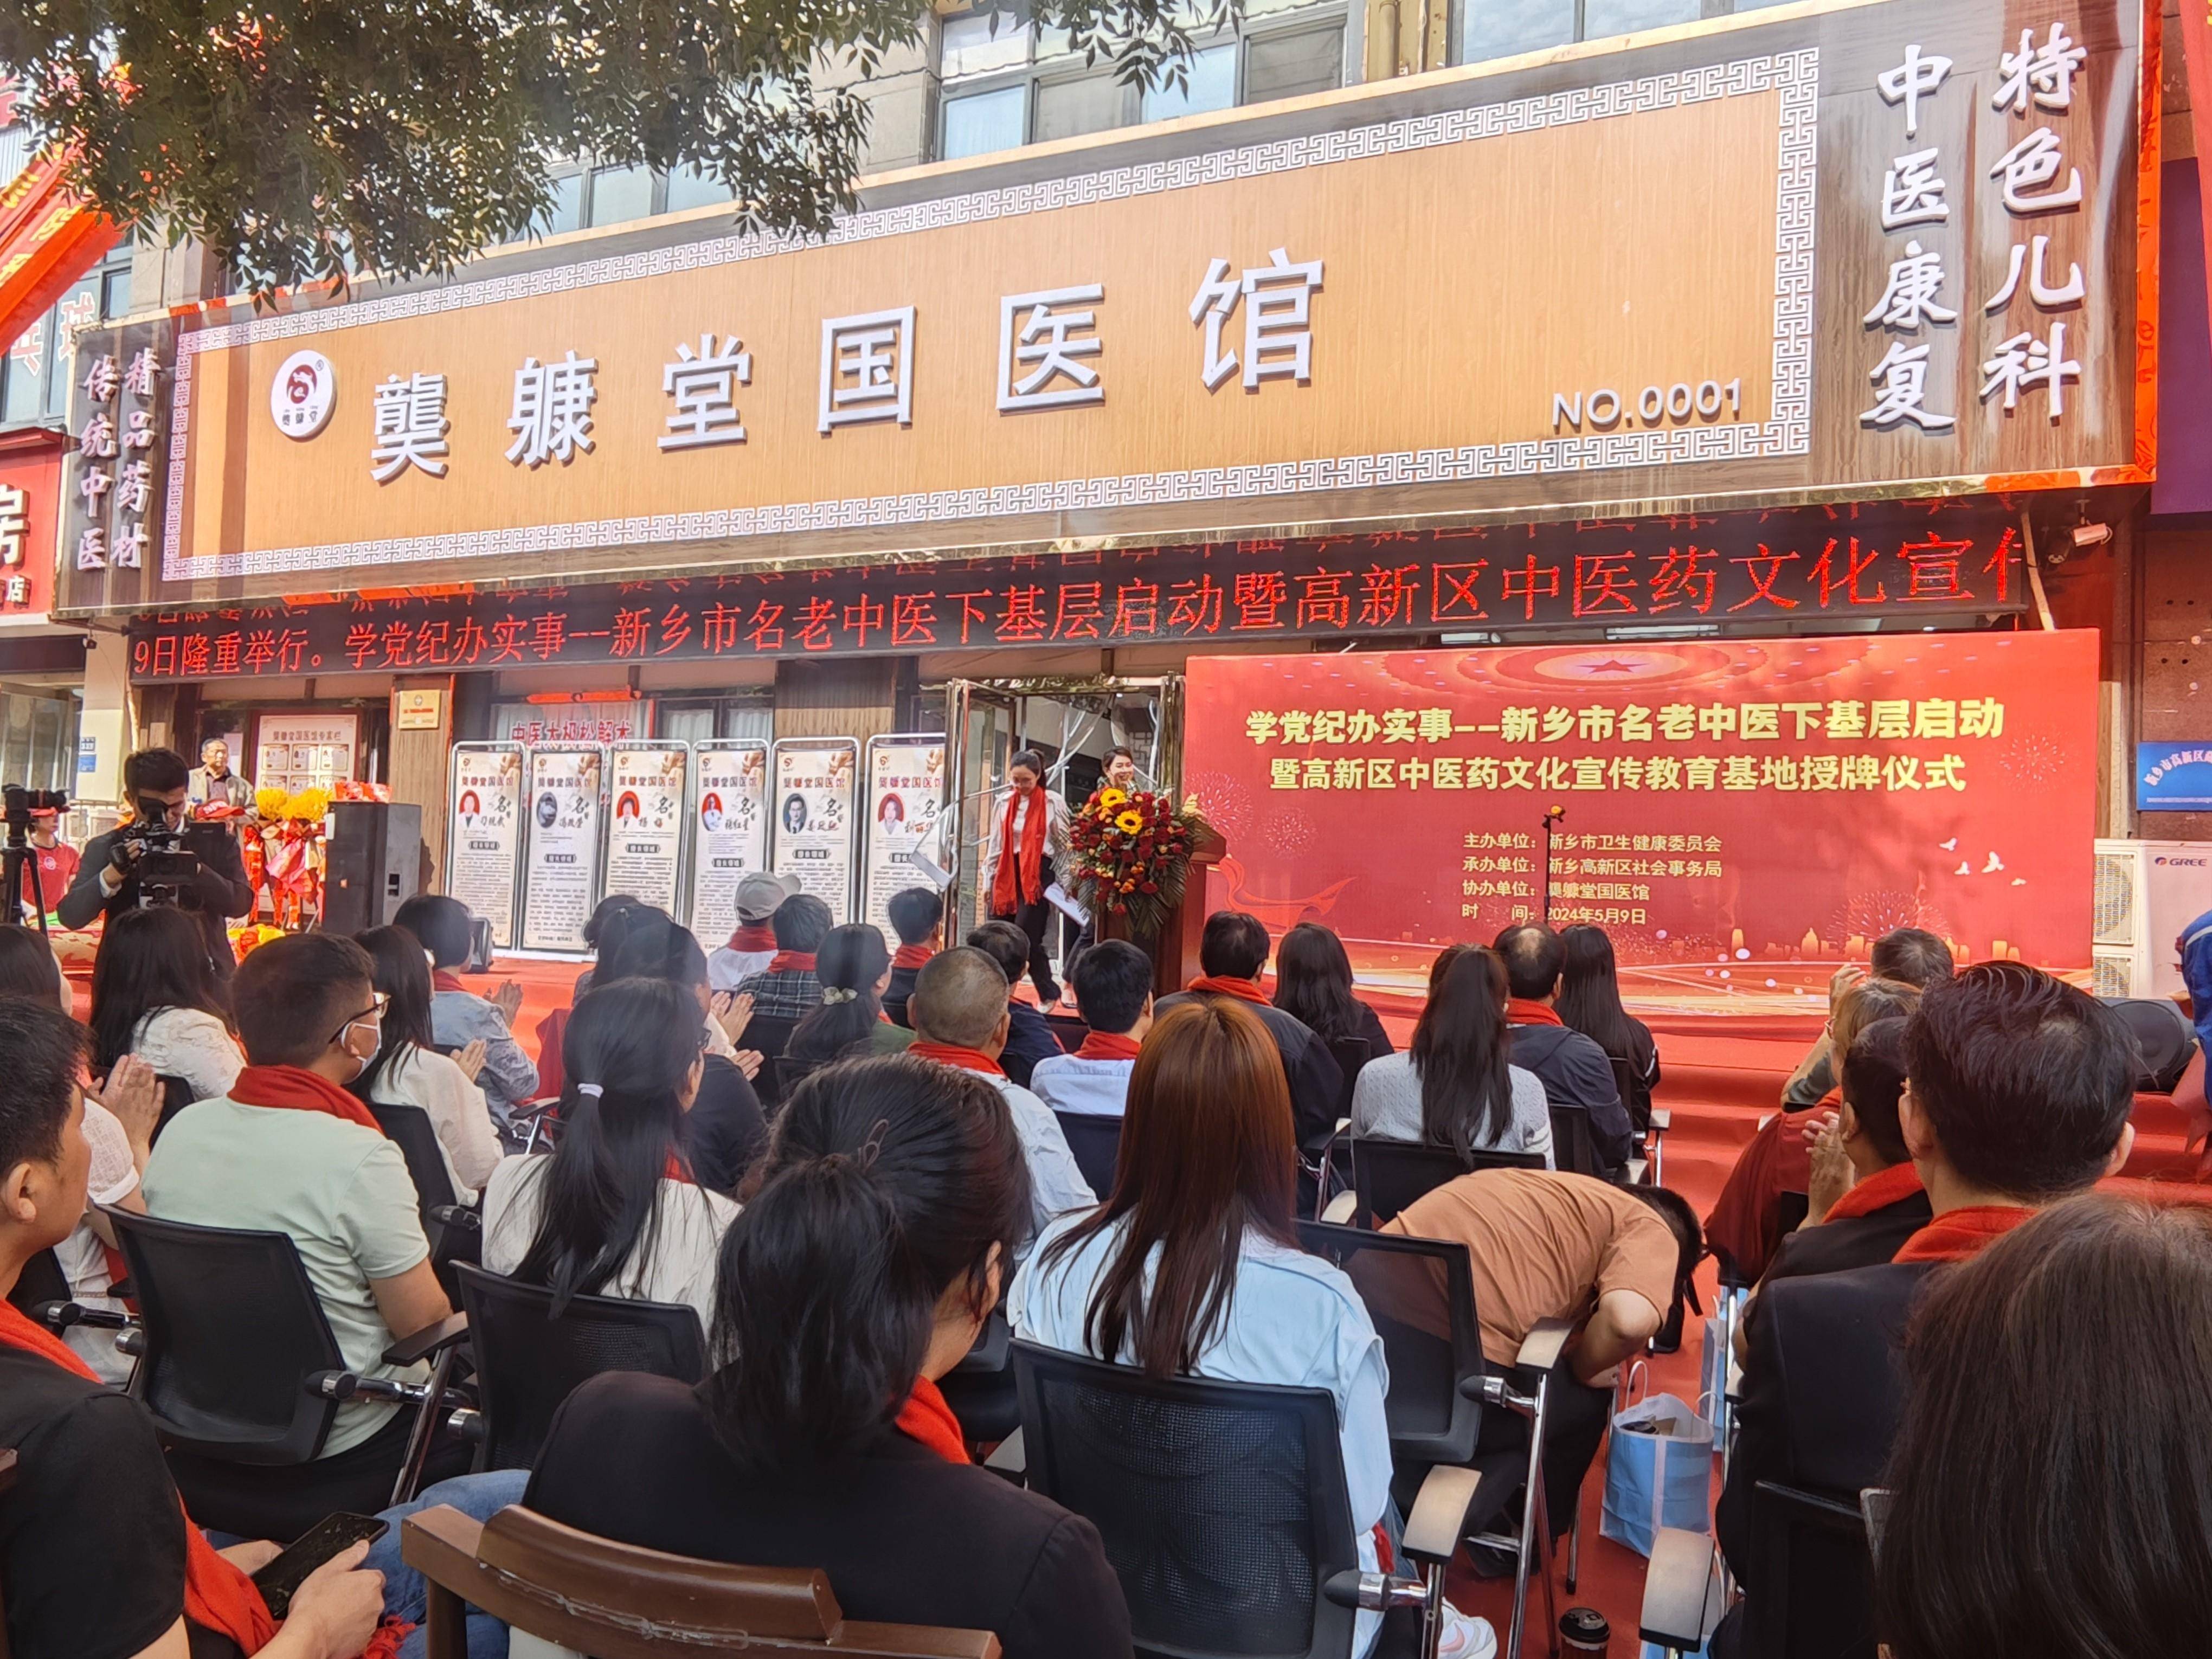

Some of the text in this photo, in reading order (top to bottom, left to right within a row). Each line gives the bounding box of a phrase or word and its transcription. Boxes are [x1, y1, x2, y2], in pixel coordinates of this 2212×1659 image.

[1860, 44, 1957, 428] 中医康复
[1979, 22, 2086, 417] 特色儿科
[78, 355, 118, 570] 传统中医
[112, 348, 160, 568] 精品药材
[1552, 378, 1740, 426] NO.0001
[1270, 755, 1966, 792] 暨高新区中医药文化宣传教育基地授牌仪式
[2169, 858, 2207, 866] GREE
